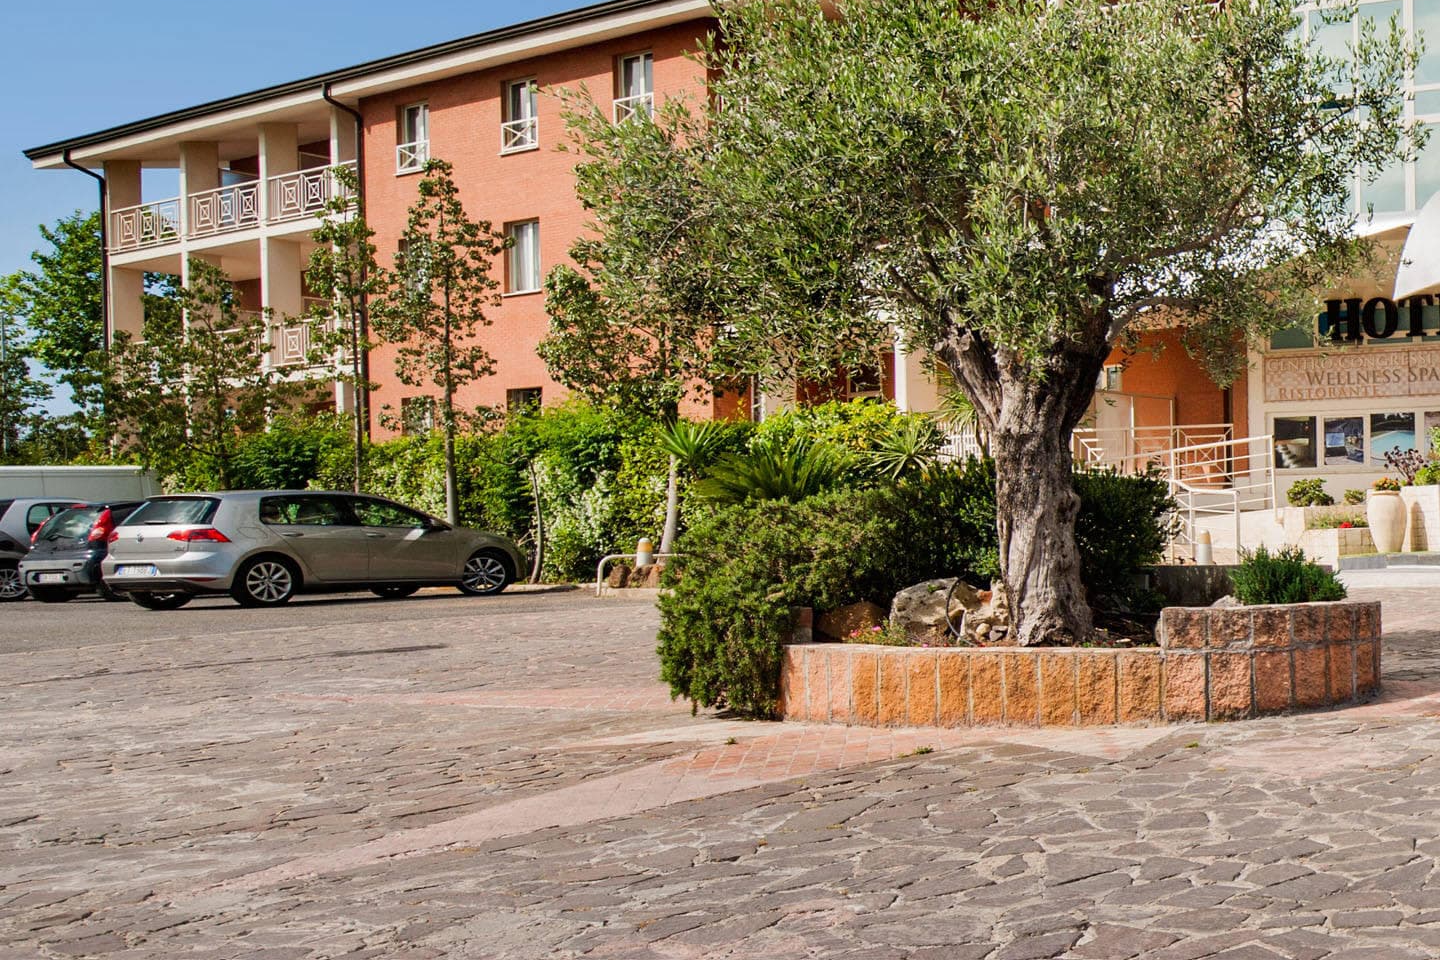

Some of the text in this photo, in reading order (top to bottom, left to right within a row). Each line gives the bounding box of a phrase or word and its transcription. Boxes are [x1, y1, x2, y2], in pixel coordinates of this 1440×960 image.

[1338, 352, 1433, 370] CONGRESSI
[1305, 367, 1440, 386] WELLNESS SPA
[1279, 384, 1378, 400] RISTORANTE
